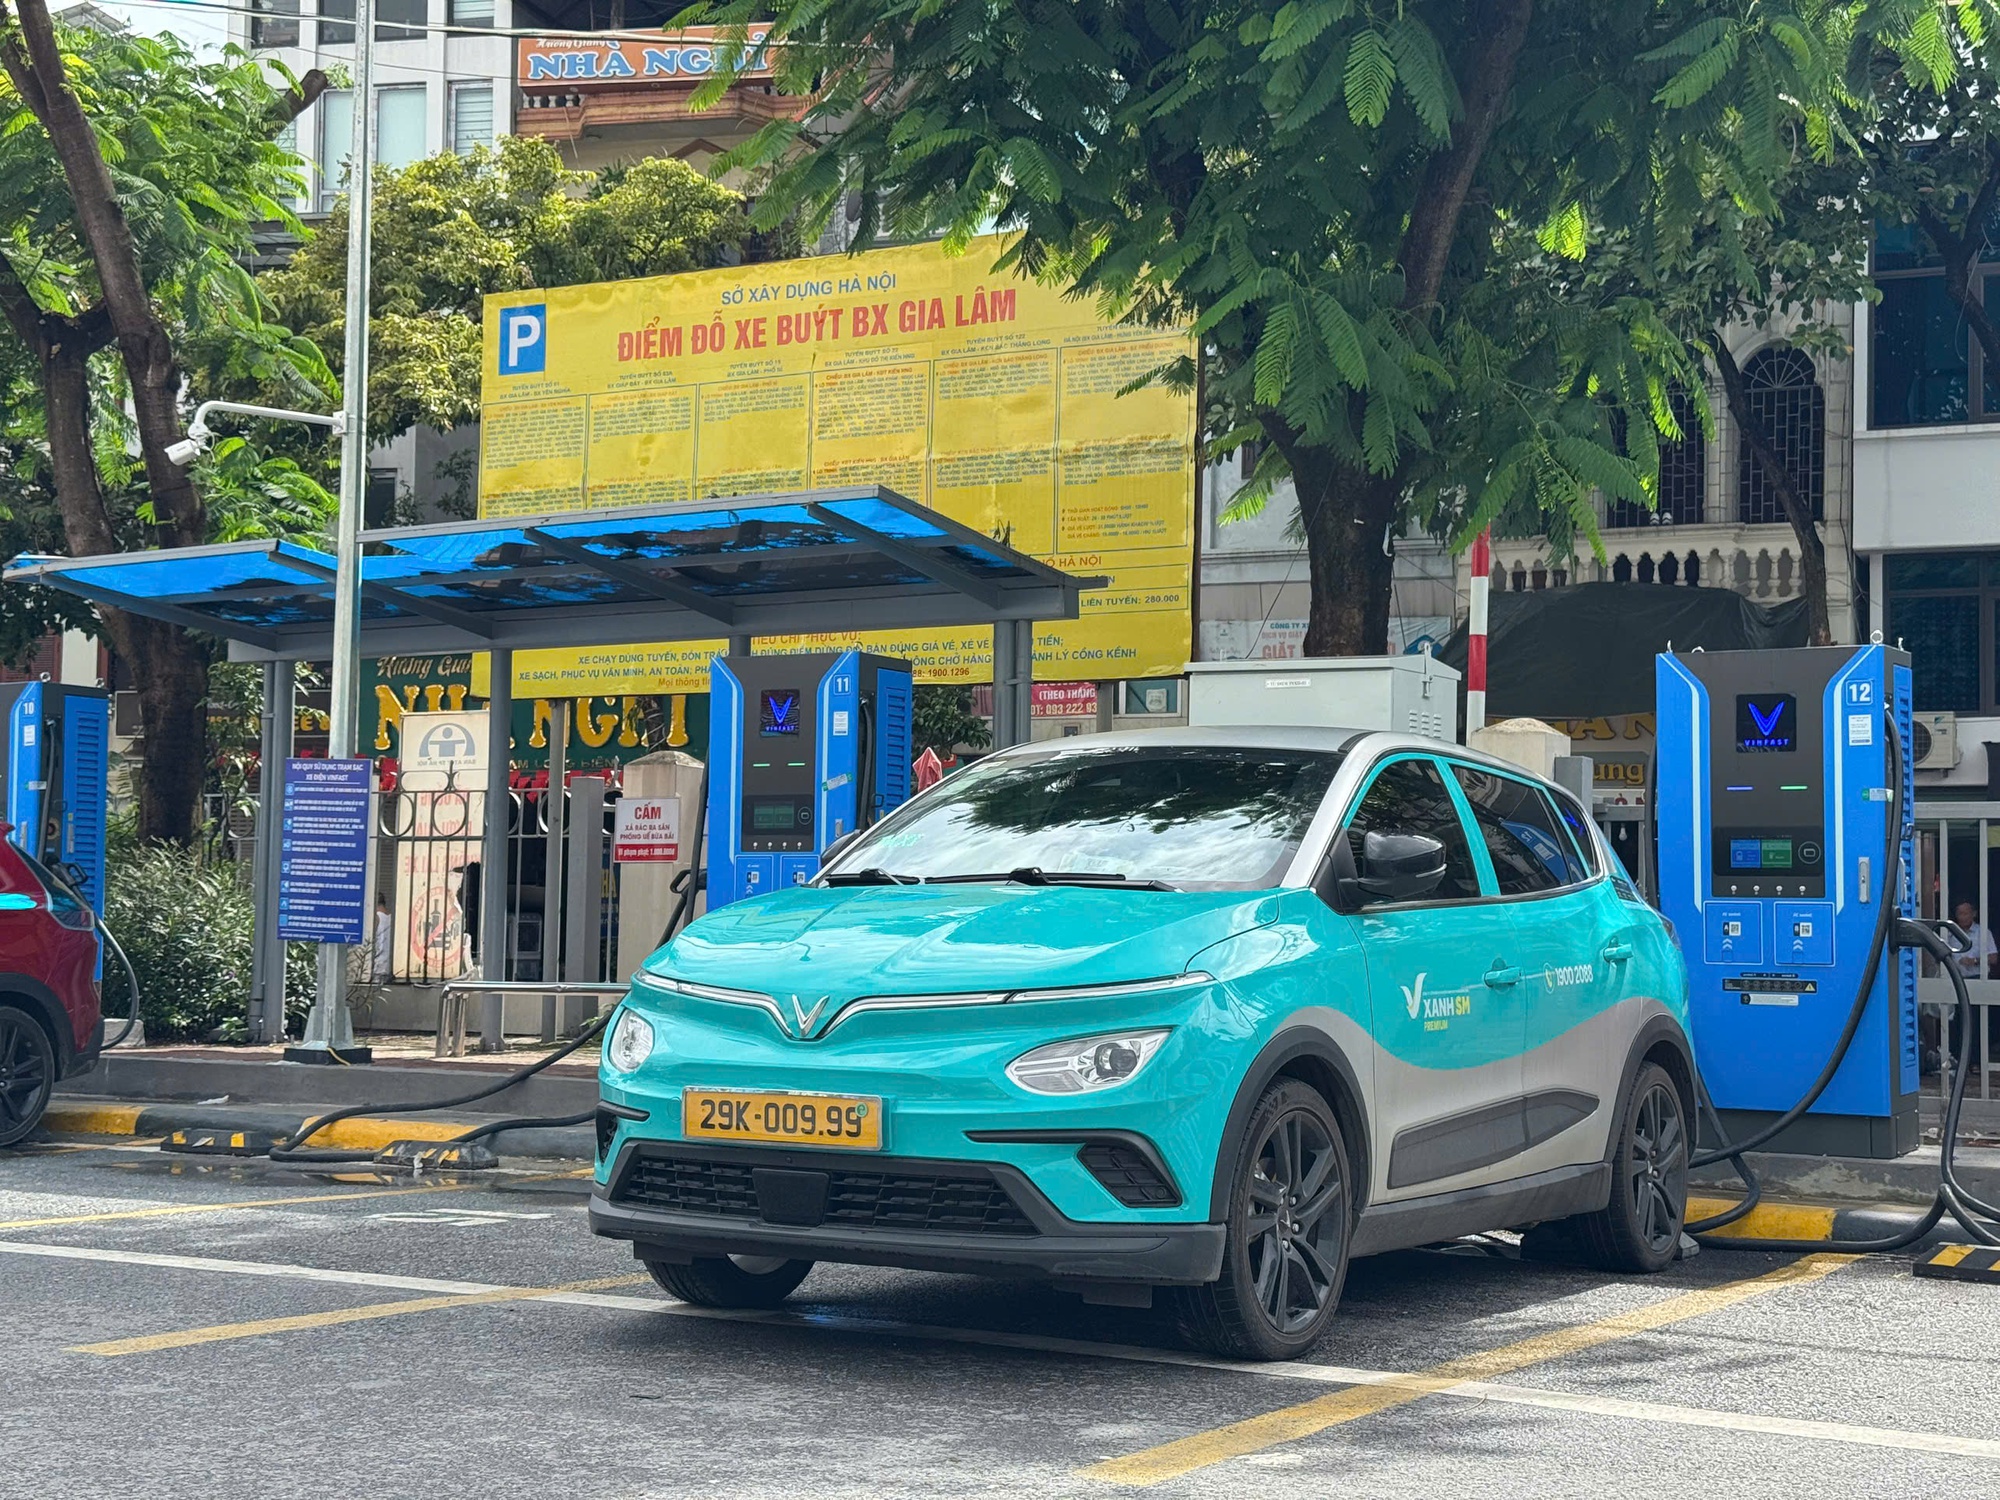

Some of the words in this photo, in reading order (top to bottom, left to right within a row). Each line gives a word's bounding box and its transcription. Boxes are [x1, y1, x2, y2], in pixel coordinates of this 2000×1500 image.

[527, 40, 634, 79] NHÀ
[721, 283, 744, 305] SỞ
[748, 283, 781, 303] XÂY
[786, 280, 833, 301] DỰNG
[839, 273, 862, 294] HÀ
[866, 270, 896, 293] NỘI
[617, 316, 683, 362] ĐIỂM
[691, 309, 725, 355] ĐỖ
[734, 316, 767, 351] XE
[776, 303, 844, 346] BUÝT
[852, 303, 889, 338] BX
[899, 297, 946, 334] GIA
[955, 285, 1016, 327] LÂM
[508, 315, 542, 367] P
[1058, 555, 1076, 567] HÀ
[1079, 554, 1102, 567] NỘI
[1081, 597, 1103, 607] LIÊN
[1105, 594, 1141, 606] TUYẾN:
[1144, 594, 1180, 604] 280.000
[1270, 622, 1290, 630] CÔNG
[578, 656, 590, 665] XE
[592, 655, 617, 666] CHẠY
[646, 652, 679, 662] TUYẾN,
[681, 651, 701, 660] ĐÓN
[866, 644, 887, 654] BÁN
[889, 640, 919, 652] ĐÚNG
[921, 640, 939, 651] GIÁ
[960, 638, 974, 650] XÉ
[976, 637, 990, 649] VÉ
[437, 655, 473, 677] Gian
[519, 672, 530, 680] XE
[532, 671, 559, 682] SẠCH,
[561, 669, 586, 680] PHỤC
[588, 669, 600, 680] VỤ
[622, 668, 647, 677] MINH,
[649, 668, 663, 676] AN
[938, 652, 961, 665] CHỞ
[963, 652, 992, 664] HÀNG
[1031, 650, 1053, 661] ÀNH
[1055, 649, 1070, 661] LÝ
[928, 667, 970, 677] 1900.1296
[835, 677, 849, 693] 11
[1039, 688, 1065, 701] (THEO
[1849, 682, 1872, 702] 12
[23, 702, 35, 715] 10
[1046, 704, 1064, 714] 093
[1066, 703, 1084, 714] 222
[1744, 738, 1789, 746] VINFAST
[634, 801, 662, 820] CẤM
[1555, 966, 1574, 987] 1900
[1574, 964, 1593, 985] 2088
[1423, 996, 1455, 1019] XANH
[1455, 995, 1471, 1016] SM
[1424, 1019, 1449, 1032] PREMIUM
[700, 1099, 862, 1138] 29K-009.99
